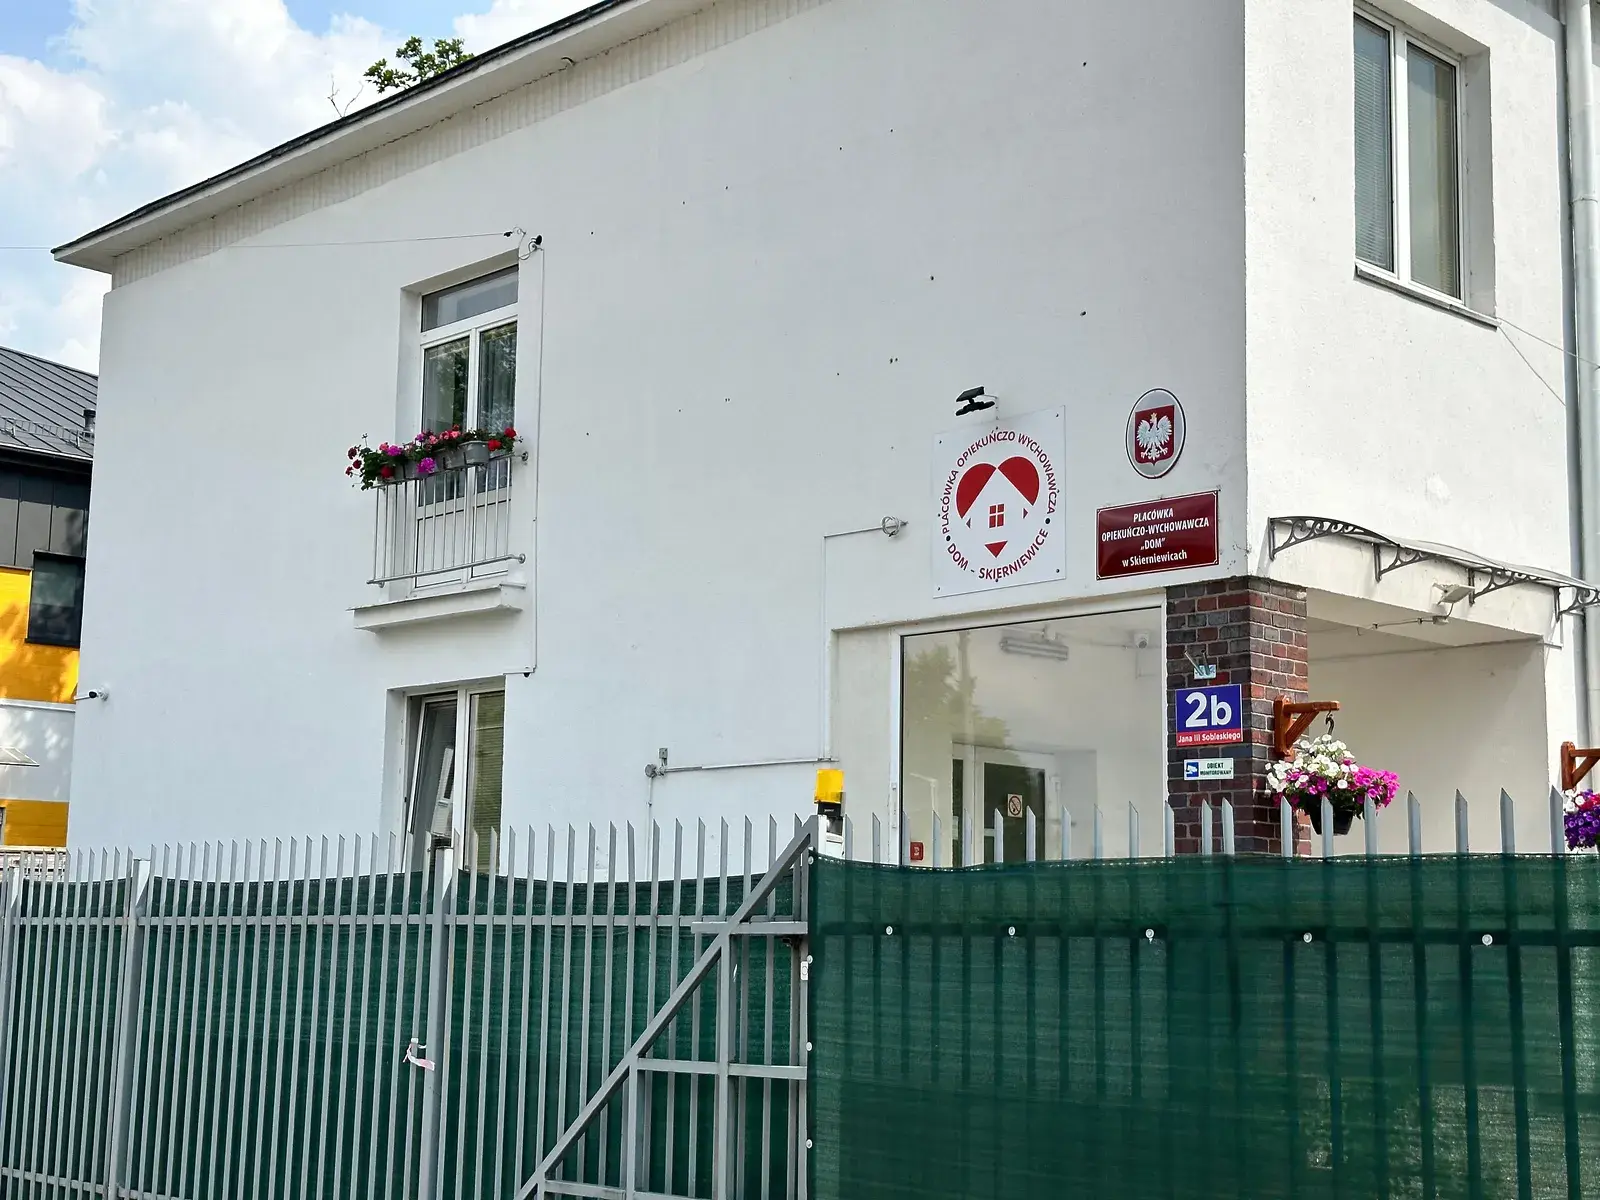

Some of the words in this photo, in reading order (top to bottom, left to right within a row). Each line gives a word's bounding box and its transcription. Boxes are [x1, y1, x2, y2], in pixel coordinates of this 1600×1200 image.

[940, 470, 958, 534] PLACÓWKA
[957, 430, 1015, 467] OPIEKUŃCZO
[1018, 433, 1057, 514] WYCHOWAWCZA
[1133, 508, 1173, 522] PLACÓWKA
[1101, 517, 1209, 541] OPIEKUŃCZO-WYCHOWAWCZA
[947, 543, 968, 571] DOM
[978, 528, 1049, 580] SKIERNIEWICE
[1122, 559, 1129, 567] w
[1130, 549, 1187, 566] Skierniewicach
[1185, 691, 1232, 727] 2b
[1178, 735, 1192, 743] Jana
[1202, 731, 1240, 741] Sobieskiego
